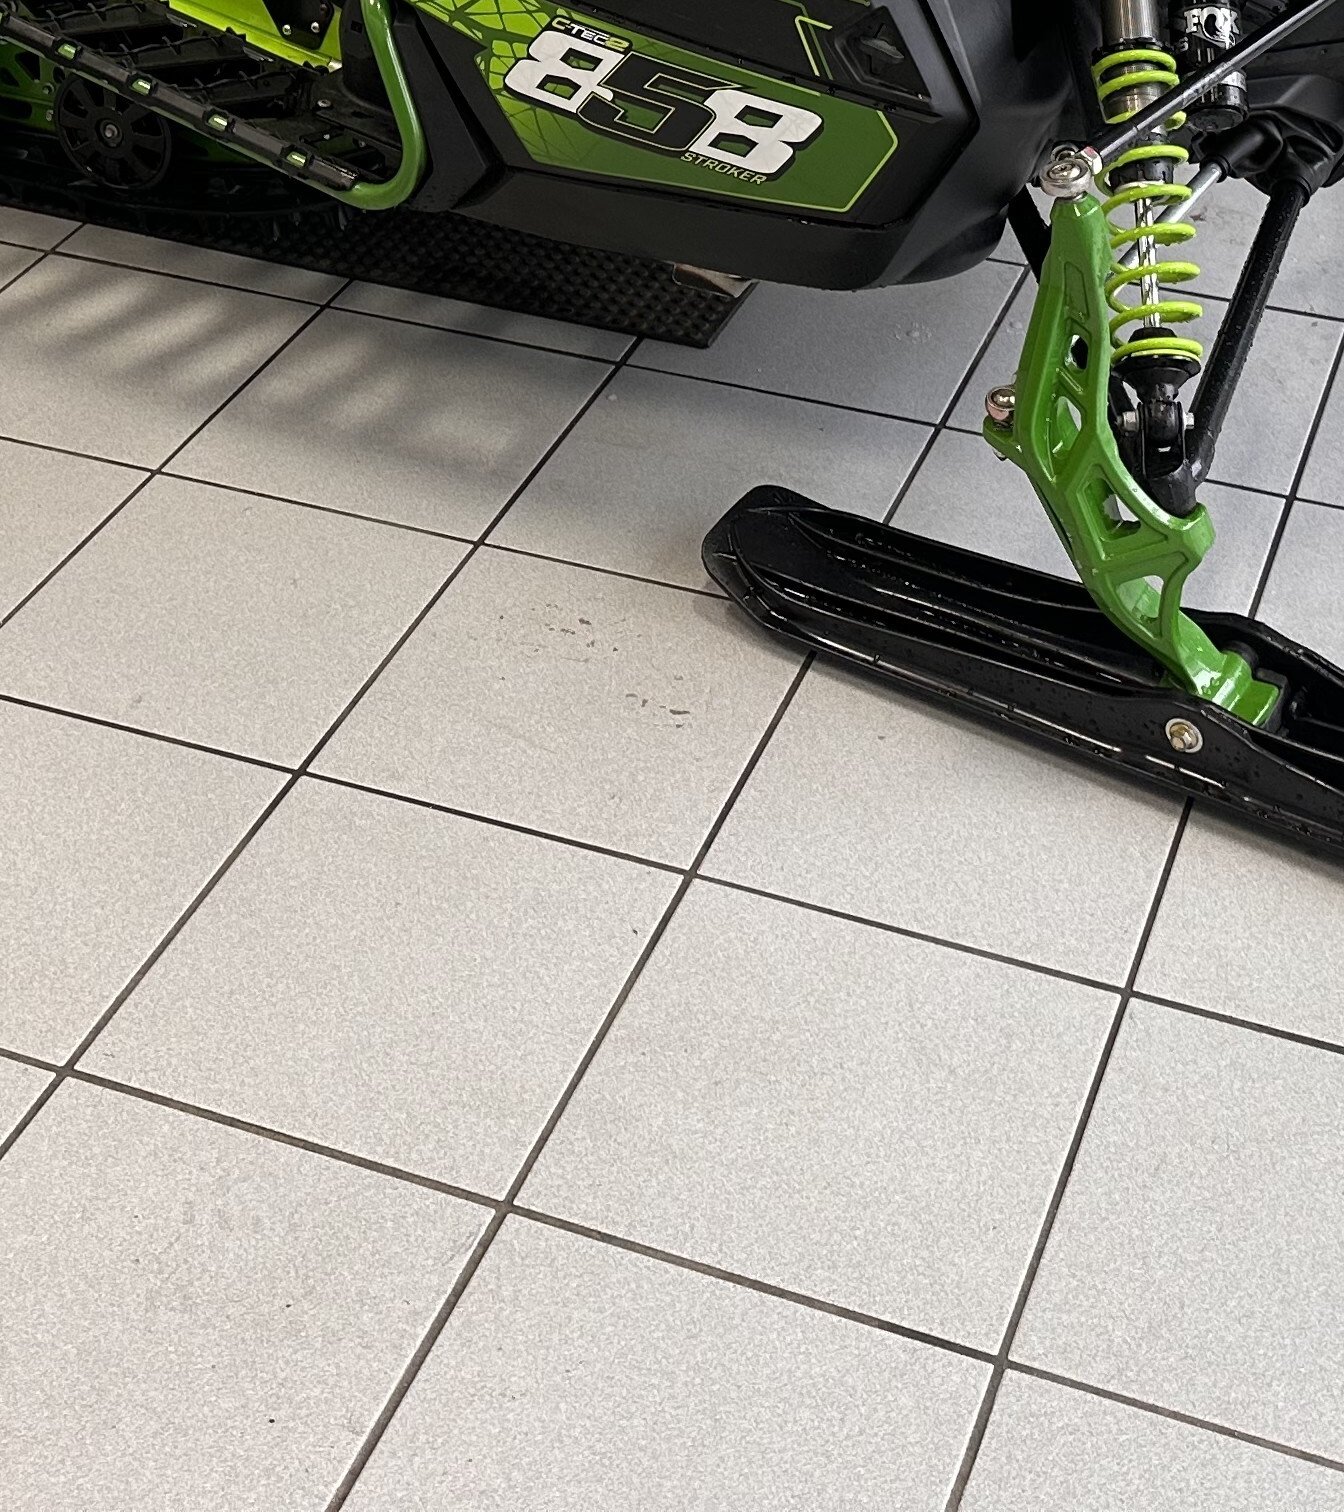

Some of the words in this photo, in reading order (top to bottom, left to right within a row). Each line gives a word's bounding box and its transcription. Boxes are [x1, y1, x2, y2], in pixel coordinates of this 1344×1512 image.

[1184, 7, 1240, 38] FOX
[504, 29, 823, 175] 858
[680, 151, 768, 186] STROKER
